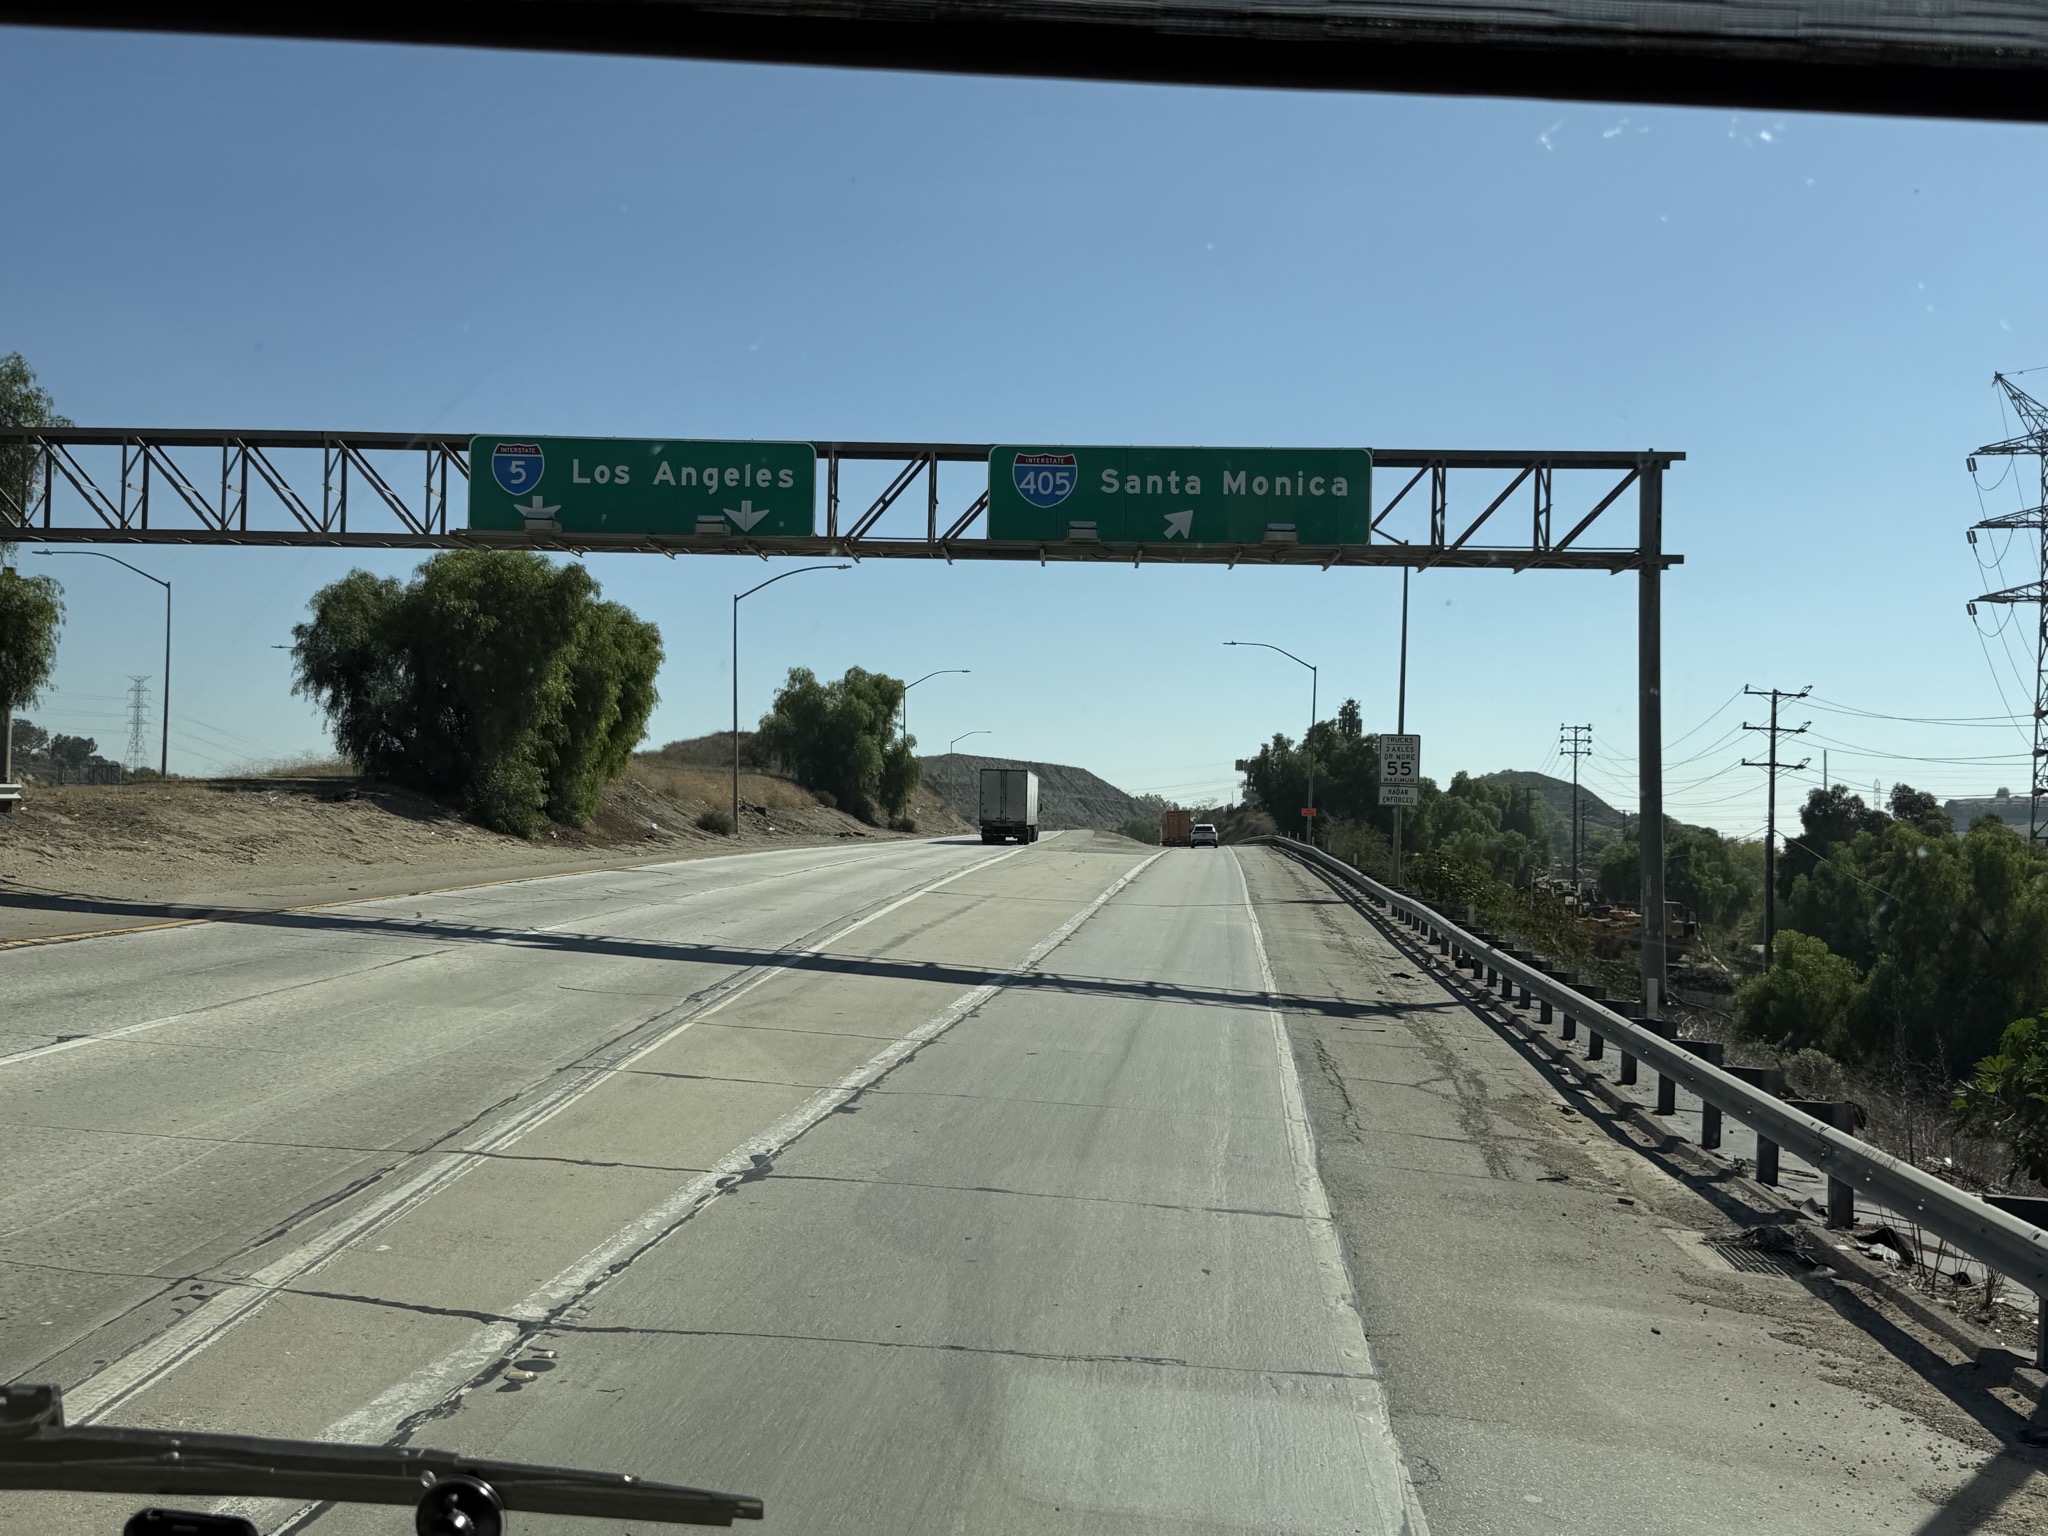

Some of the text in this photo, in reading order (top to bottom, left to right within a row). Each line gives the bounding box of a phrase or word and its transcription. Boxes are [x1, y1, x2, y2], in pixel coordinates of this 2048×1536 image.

[510, 460, 527, 485] 5
[572, 458, 795, 495] Los Angeles
[1018, 471, 1071, 496] 405
[1100, 468, 1349, 498] Santa Monica
[1387, 761, 1412, 776] 55
[1382, 796, 1414, 804] ENFORCED
[1387, 788, 1409, 796] RADAR
